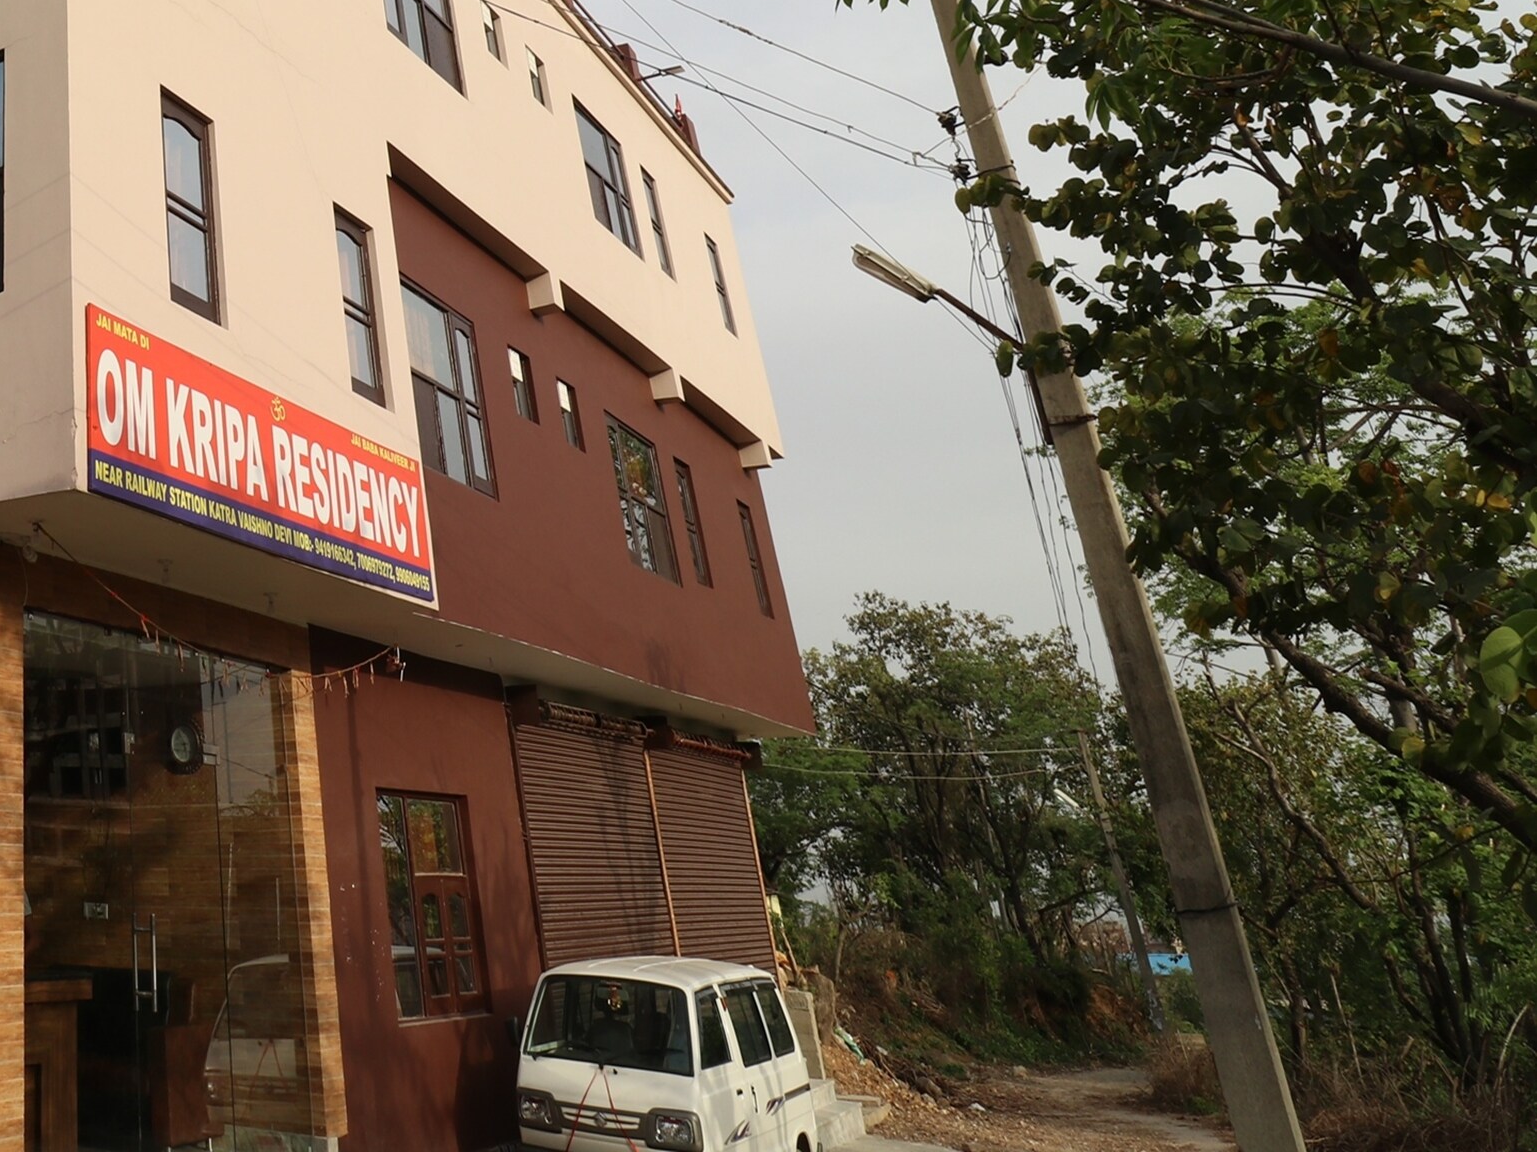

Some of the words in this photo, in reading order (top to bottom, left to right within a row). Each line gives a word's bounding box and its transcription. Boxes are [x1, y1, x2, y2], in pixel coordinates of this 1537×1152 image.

[96, 313, 110, 331] JAI
[113, 321, 138, 345] MATA
[140, 334, 150, 350] DI
[96, 348, 157, 460] OM
[165, 377, 269, 502] KRIPA
[271, 424, 420, 558] RESIDENCY
[351, 433, 361, 449] JAI
[362, 438, 380, 456] BABA
[409, 460, 416, 472] JI
[95, 459, 123, 488] NEAR
[125, 469, 168, 502] RAILWAY
[169, 485, 207, 516] STATION
[209, 500, 237, 526] KATRA
[238, 509, 273, 539] VAISHNO
[274, 522, 293, 546] DEVI
